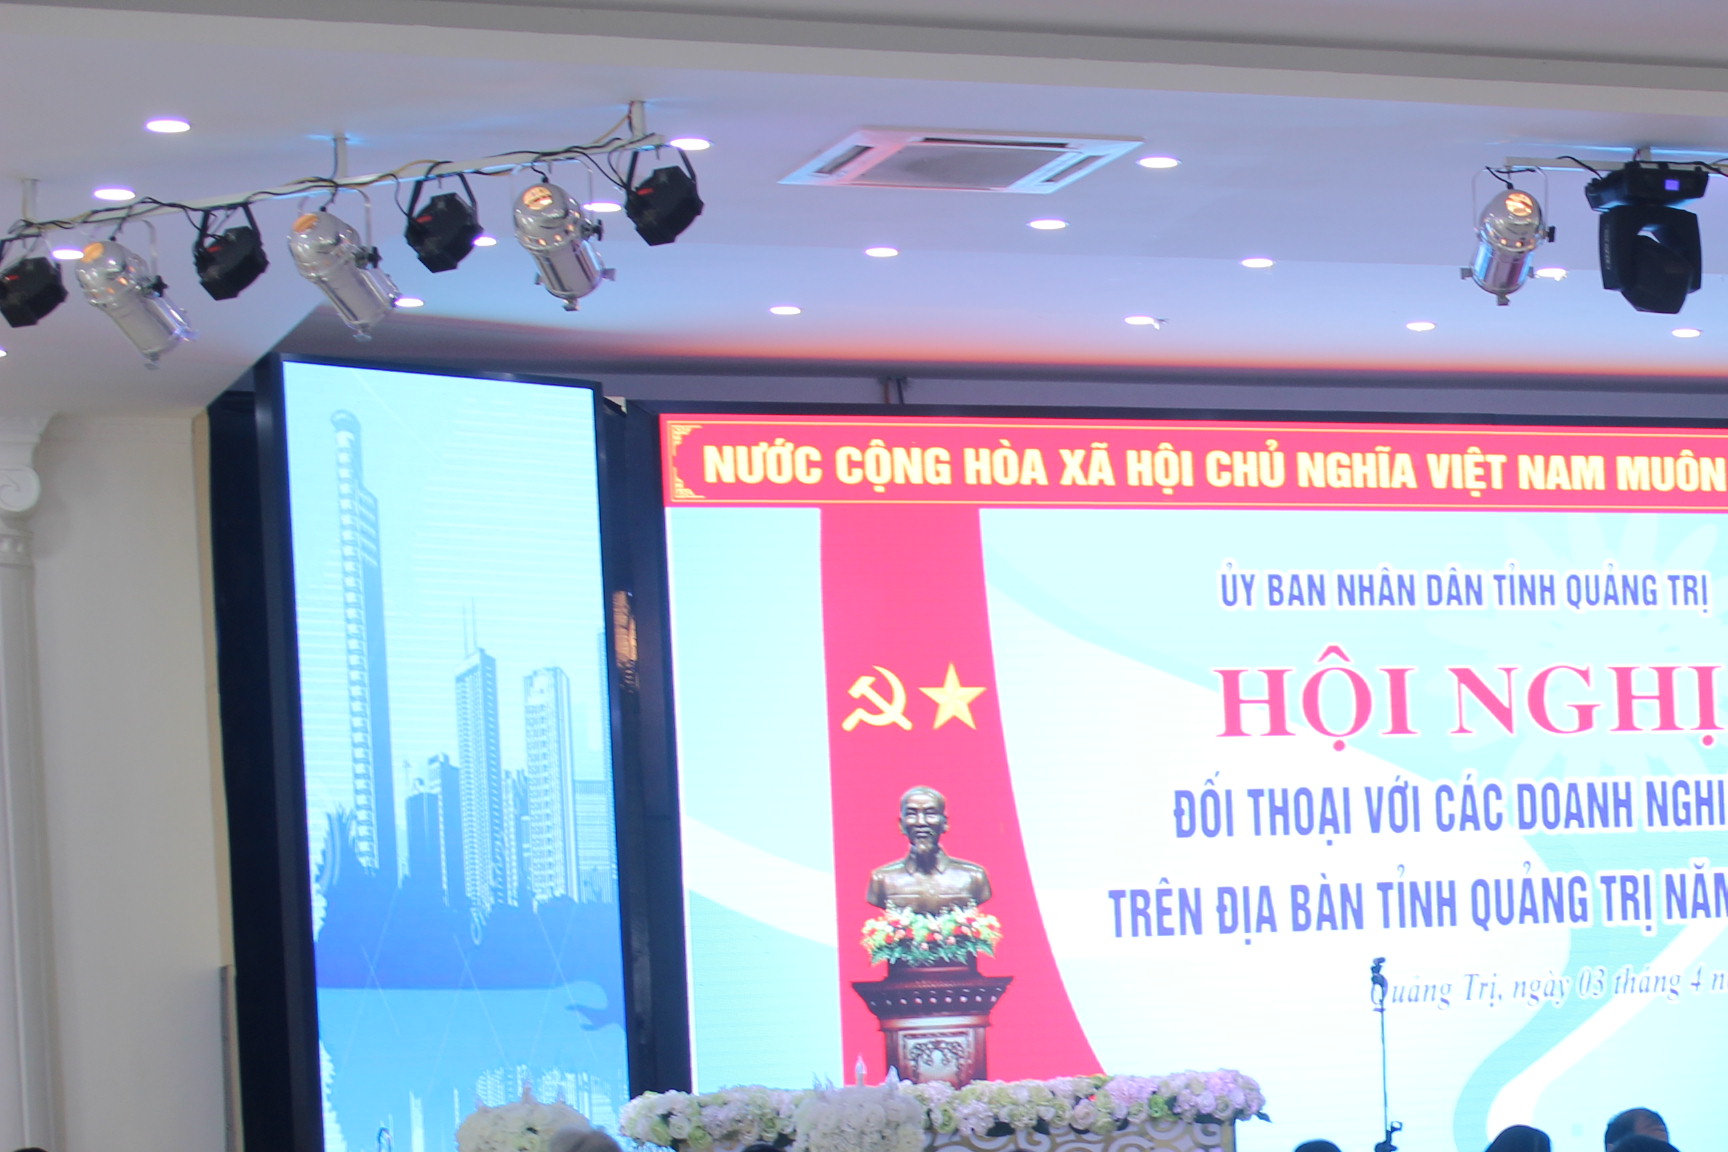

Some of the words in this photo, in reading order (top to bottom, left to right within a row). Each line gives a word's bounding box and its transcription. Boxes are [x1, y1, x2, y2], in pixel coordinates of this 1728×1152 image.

[703, 438, 822, 483] NƯỚC
[836, 439, 951, 492] CỘNG
[964, 439, 1048, 485] HÒA
[1059, 442, 1115, 486] XÃ
[1126, 443, 1194, 494] HỘI
[1206, 439, 1285, 488] CHỦ
[1297, 446, 1415, 488] NGHĨA
[1426, 447, 1507, 497] VIỆT
[1518, 455, 1605, 490] NAM
[1617, 449, 1726, 491] MUÔN
[1221, 563, 1255, 606] ỦY
[1268, 574, 1325, 606] BAN
[1338, 568, 1415, 605] NHÂN
[1427, 568, 1483, 605] DÂN
[1494, 564, 1555, 605] TỈNH
[1567, 564, 1657, 608] QUẢNG
[1668, 575, 1707, 613] TRỊ
[1213, 645, 1417, 751] HỘI
[1449, 666, 1723, 745] NGHỊ
[1174, 772, 1233, 838] ĐỐI
[1247, 787, 1351, 846] THOẠI
[1365, 776, 1420, 833] VỚI
[1436, 774, 1503, 832] CÁC
[1518, 782, 1632, 829] DOANH
[1108, 878, 1202, 937] TRÊN
[1216, 886, 1277, 945] ĐỊA
[1291, 873, 1363, 931] BÀN
[1377, 864, 1456, 928] TỈNH
[1472, 861, 1588, 931] QUẢNG
[1600, 875, 1651, 931] TRỊ
[1513, 969, 1569, 1007] ngày
[1578, 967, 1605, 998] 03
[1614, 966, 1681, 1001] tháng
[1690, 964, 1702, 992] 4
